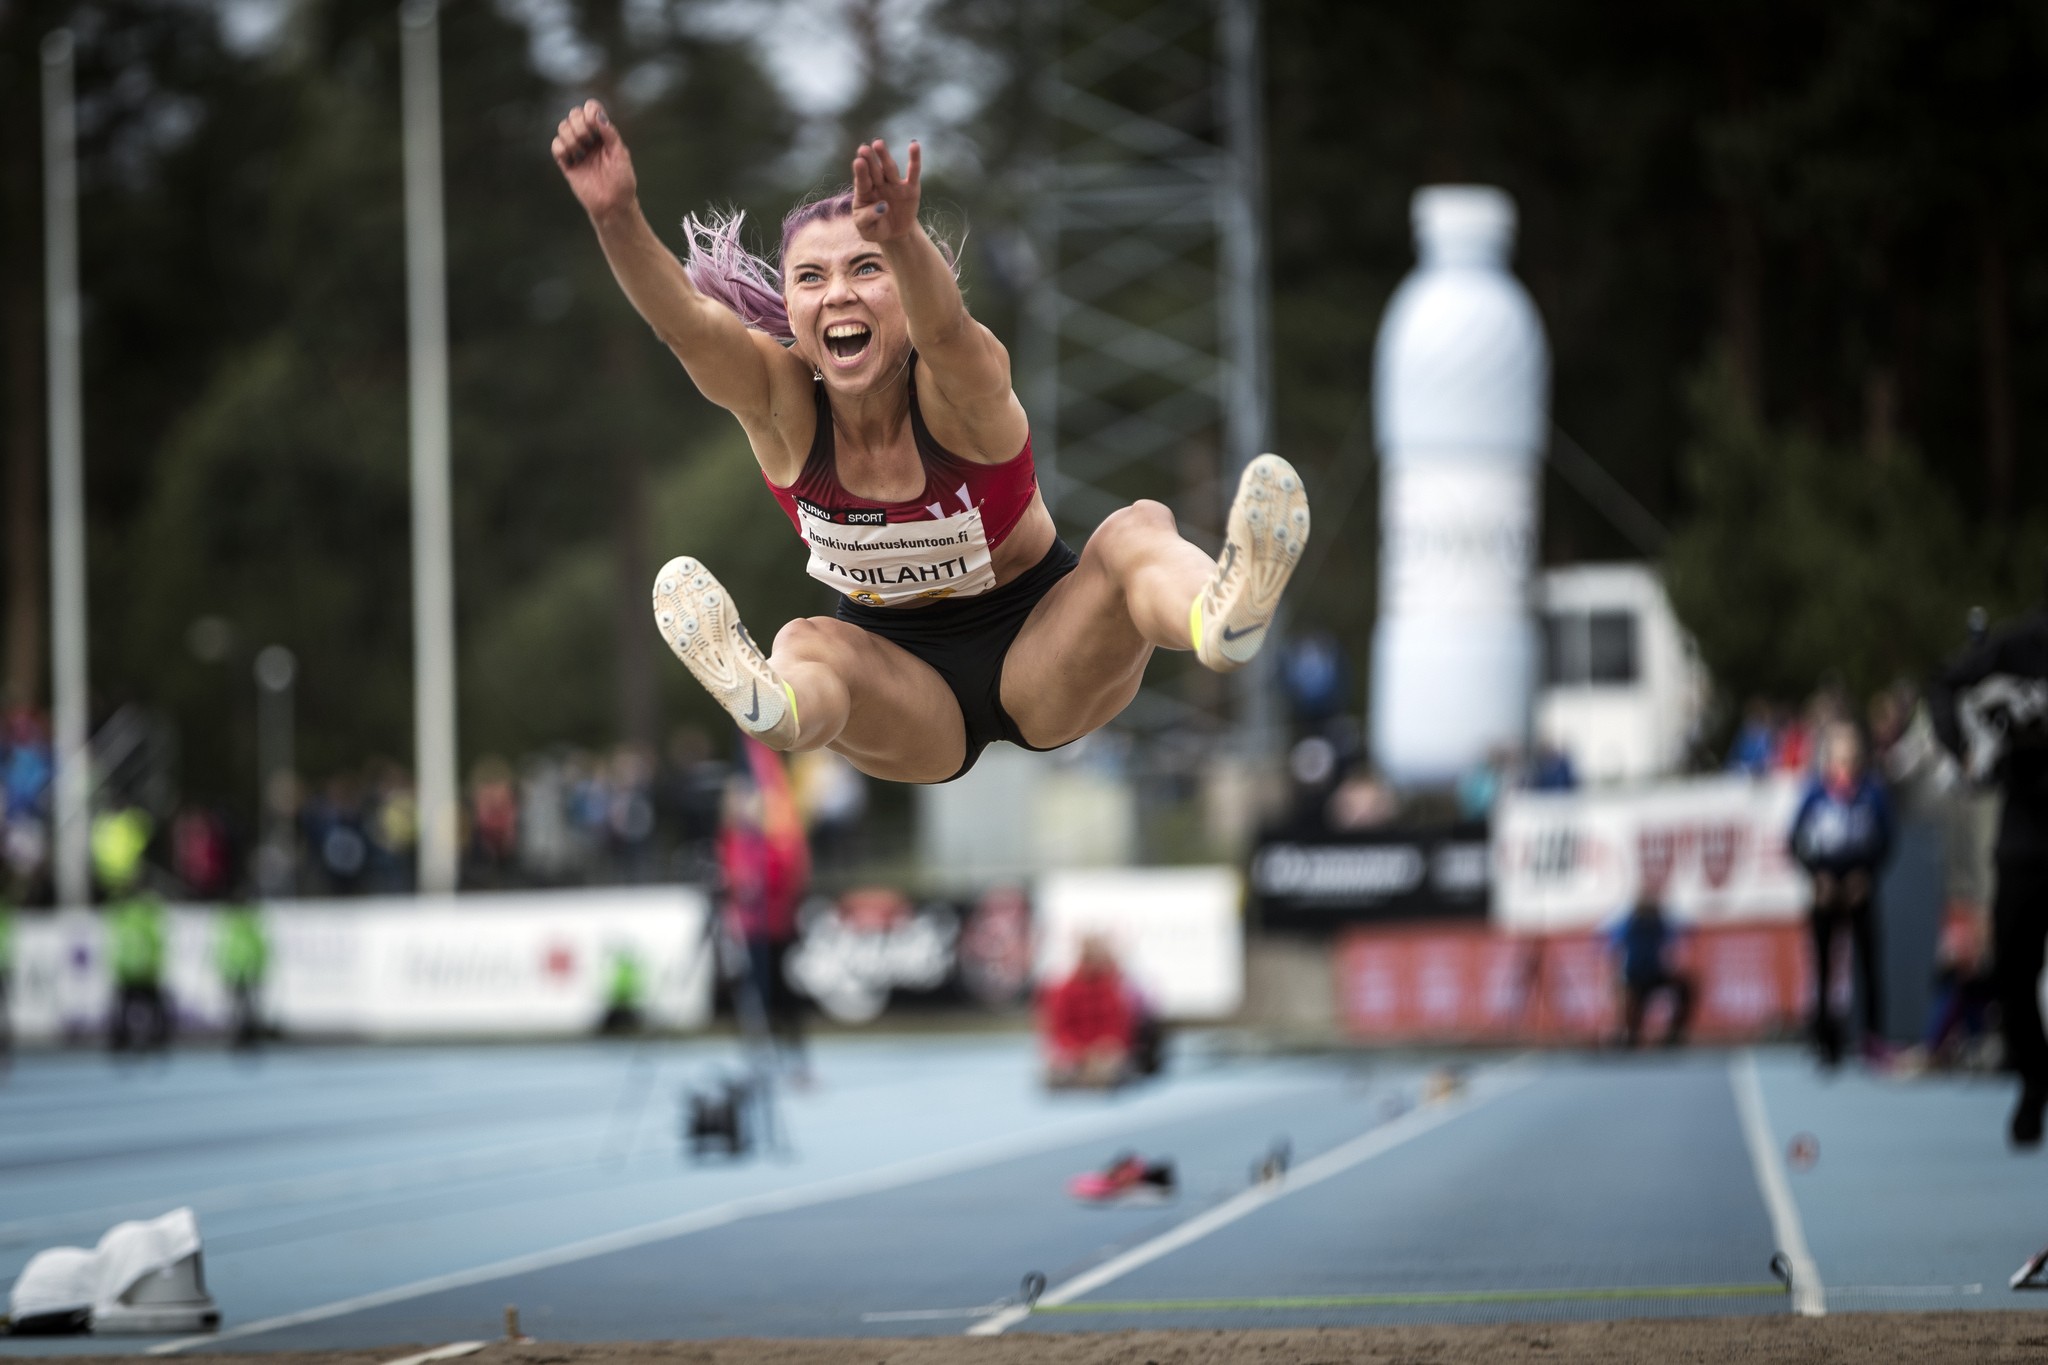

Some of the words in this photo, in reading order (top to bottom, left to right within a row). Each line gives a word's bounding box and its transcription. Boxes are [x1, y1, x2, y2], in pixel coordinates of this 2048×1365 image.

[799, 500, 831, 520] TURKU
[848, 513, 884, 523] SPORT
[809, 528, 969, 552] henkivakuutuskuntoon.fi
